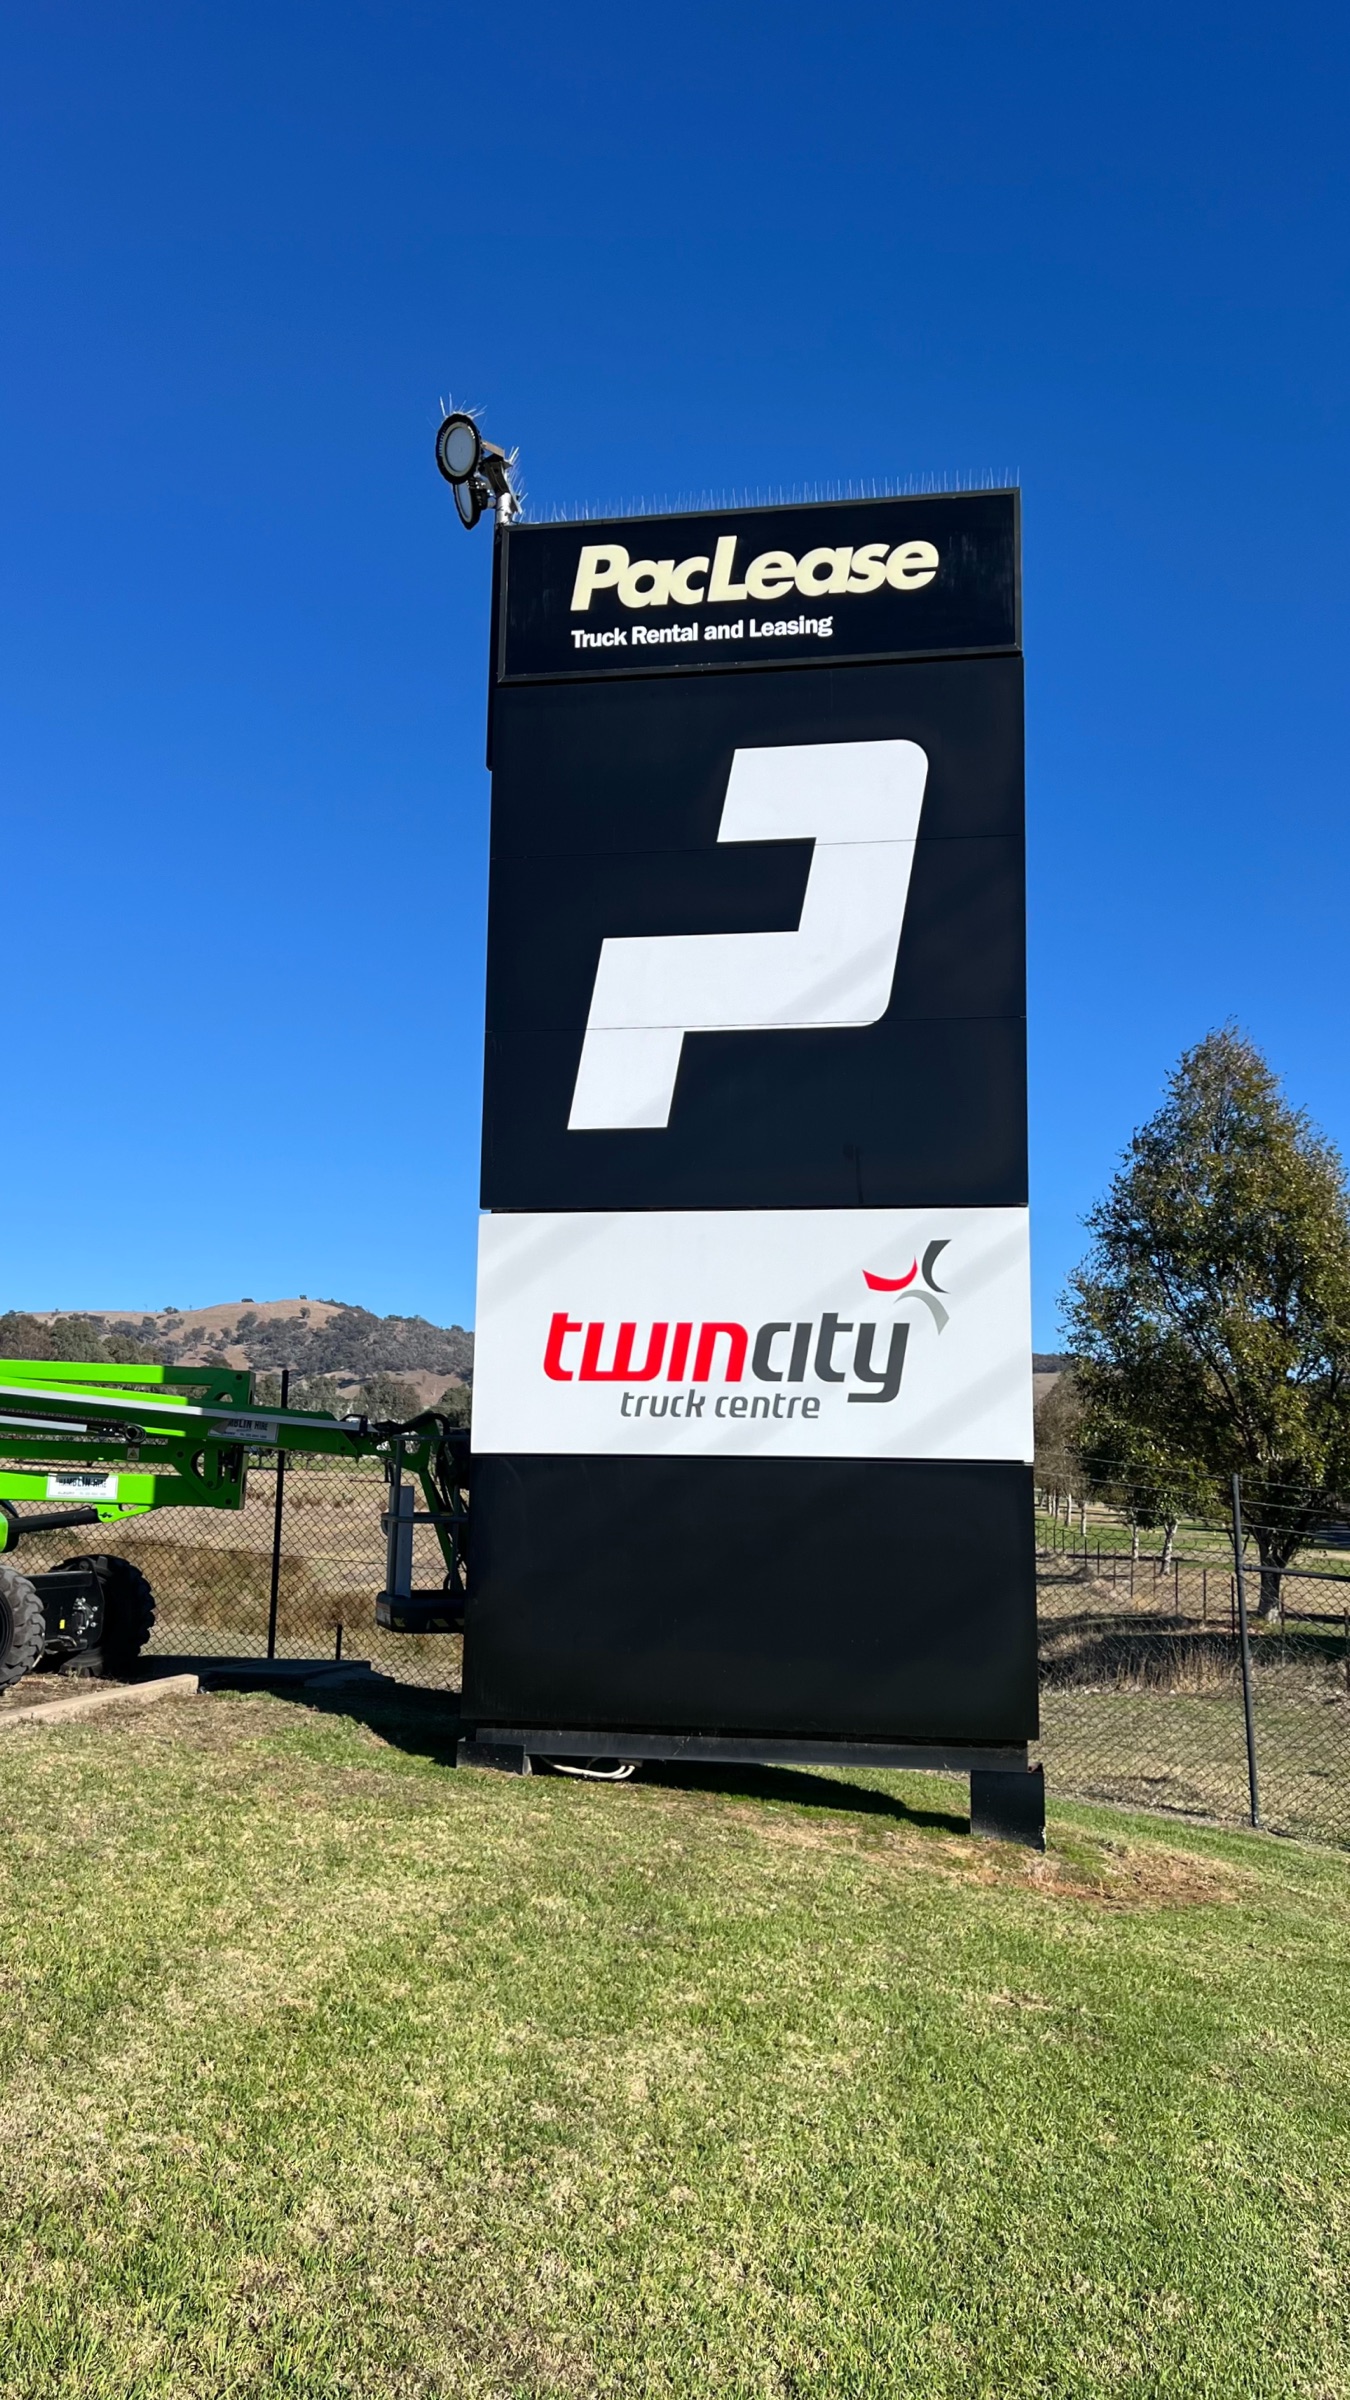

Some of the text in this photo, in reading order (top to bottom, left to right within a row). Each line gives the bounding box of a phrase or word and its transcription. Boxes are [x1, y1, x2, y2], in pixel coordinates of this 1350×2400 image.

[570, 535, 939, 611] PacLease
[571, 615, 834, 648] Truck Rental and Leasing
[620, 1389, 821, 1419] truck centre
